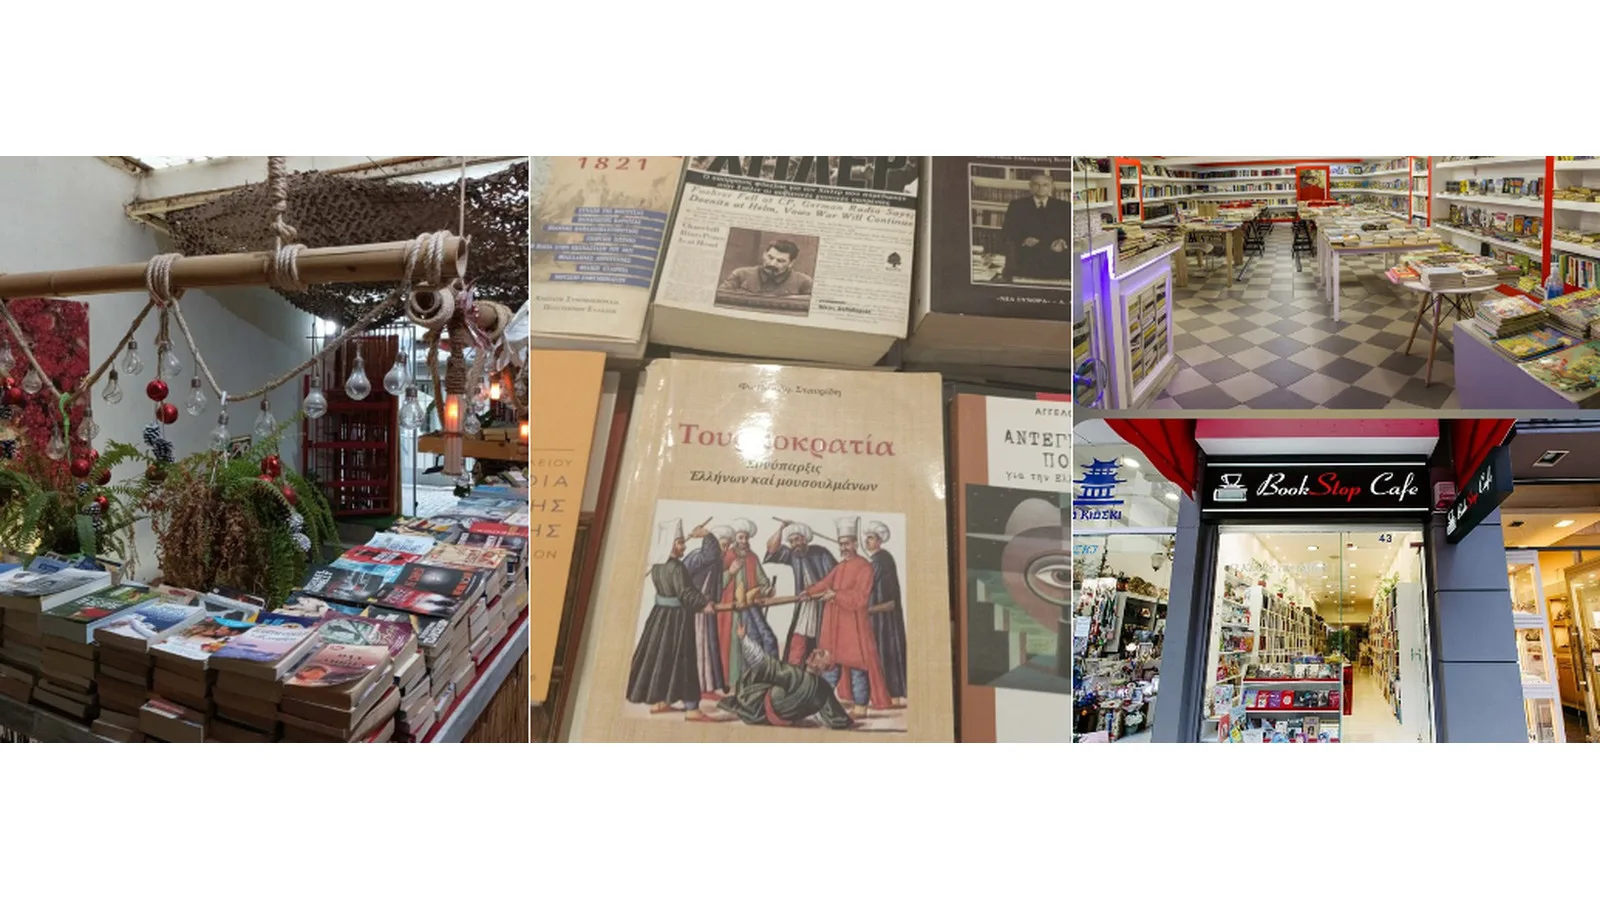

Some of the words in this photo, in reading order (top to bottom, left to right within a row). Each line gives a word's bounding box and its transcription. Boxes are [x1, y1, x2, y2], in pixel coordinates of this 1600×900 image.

[578, 157, 648, 171] 1821
[801, 200, 843, 211] German
[848, 205, 881, 214] Radio
[815, 210, 837, 219] War
[841, 212, 863, 222] Will
[866, 214, 913, 227] Continue
[776, 476, 878, 492] μουσουλμάνων
[1006, 471, 1025, 481] για
[1030, 474, 1049, 483] την
[1369, 472, 1419, 502] Cafe
[1378, 534, 1393, 543] 43
